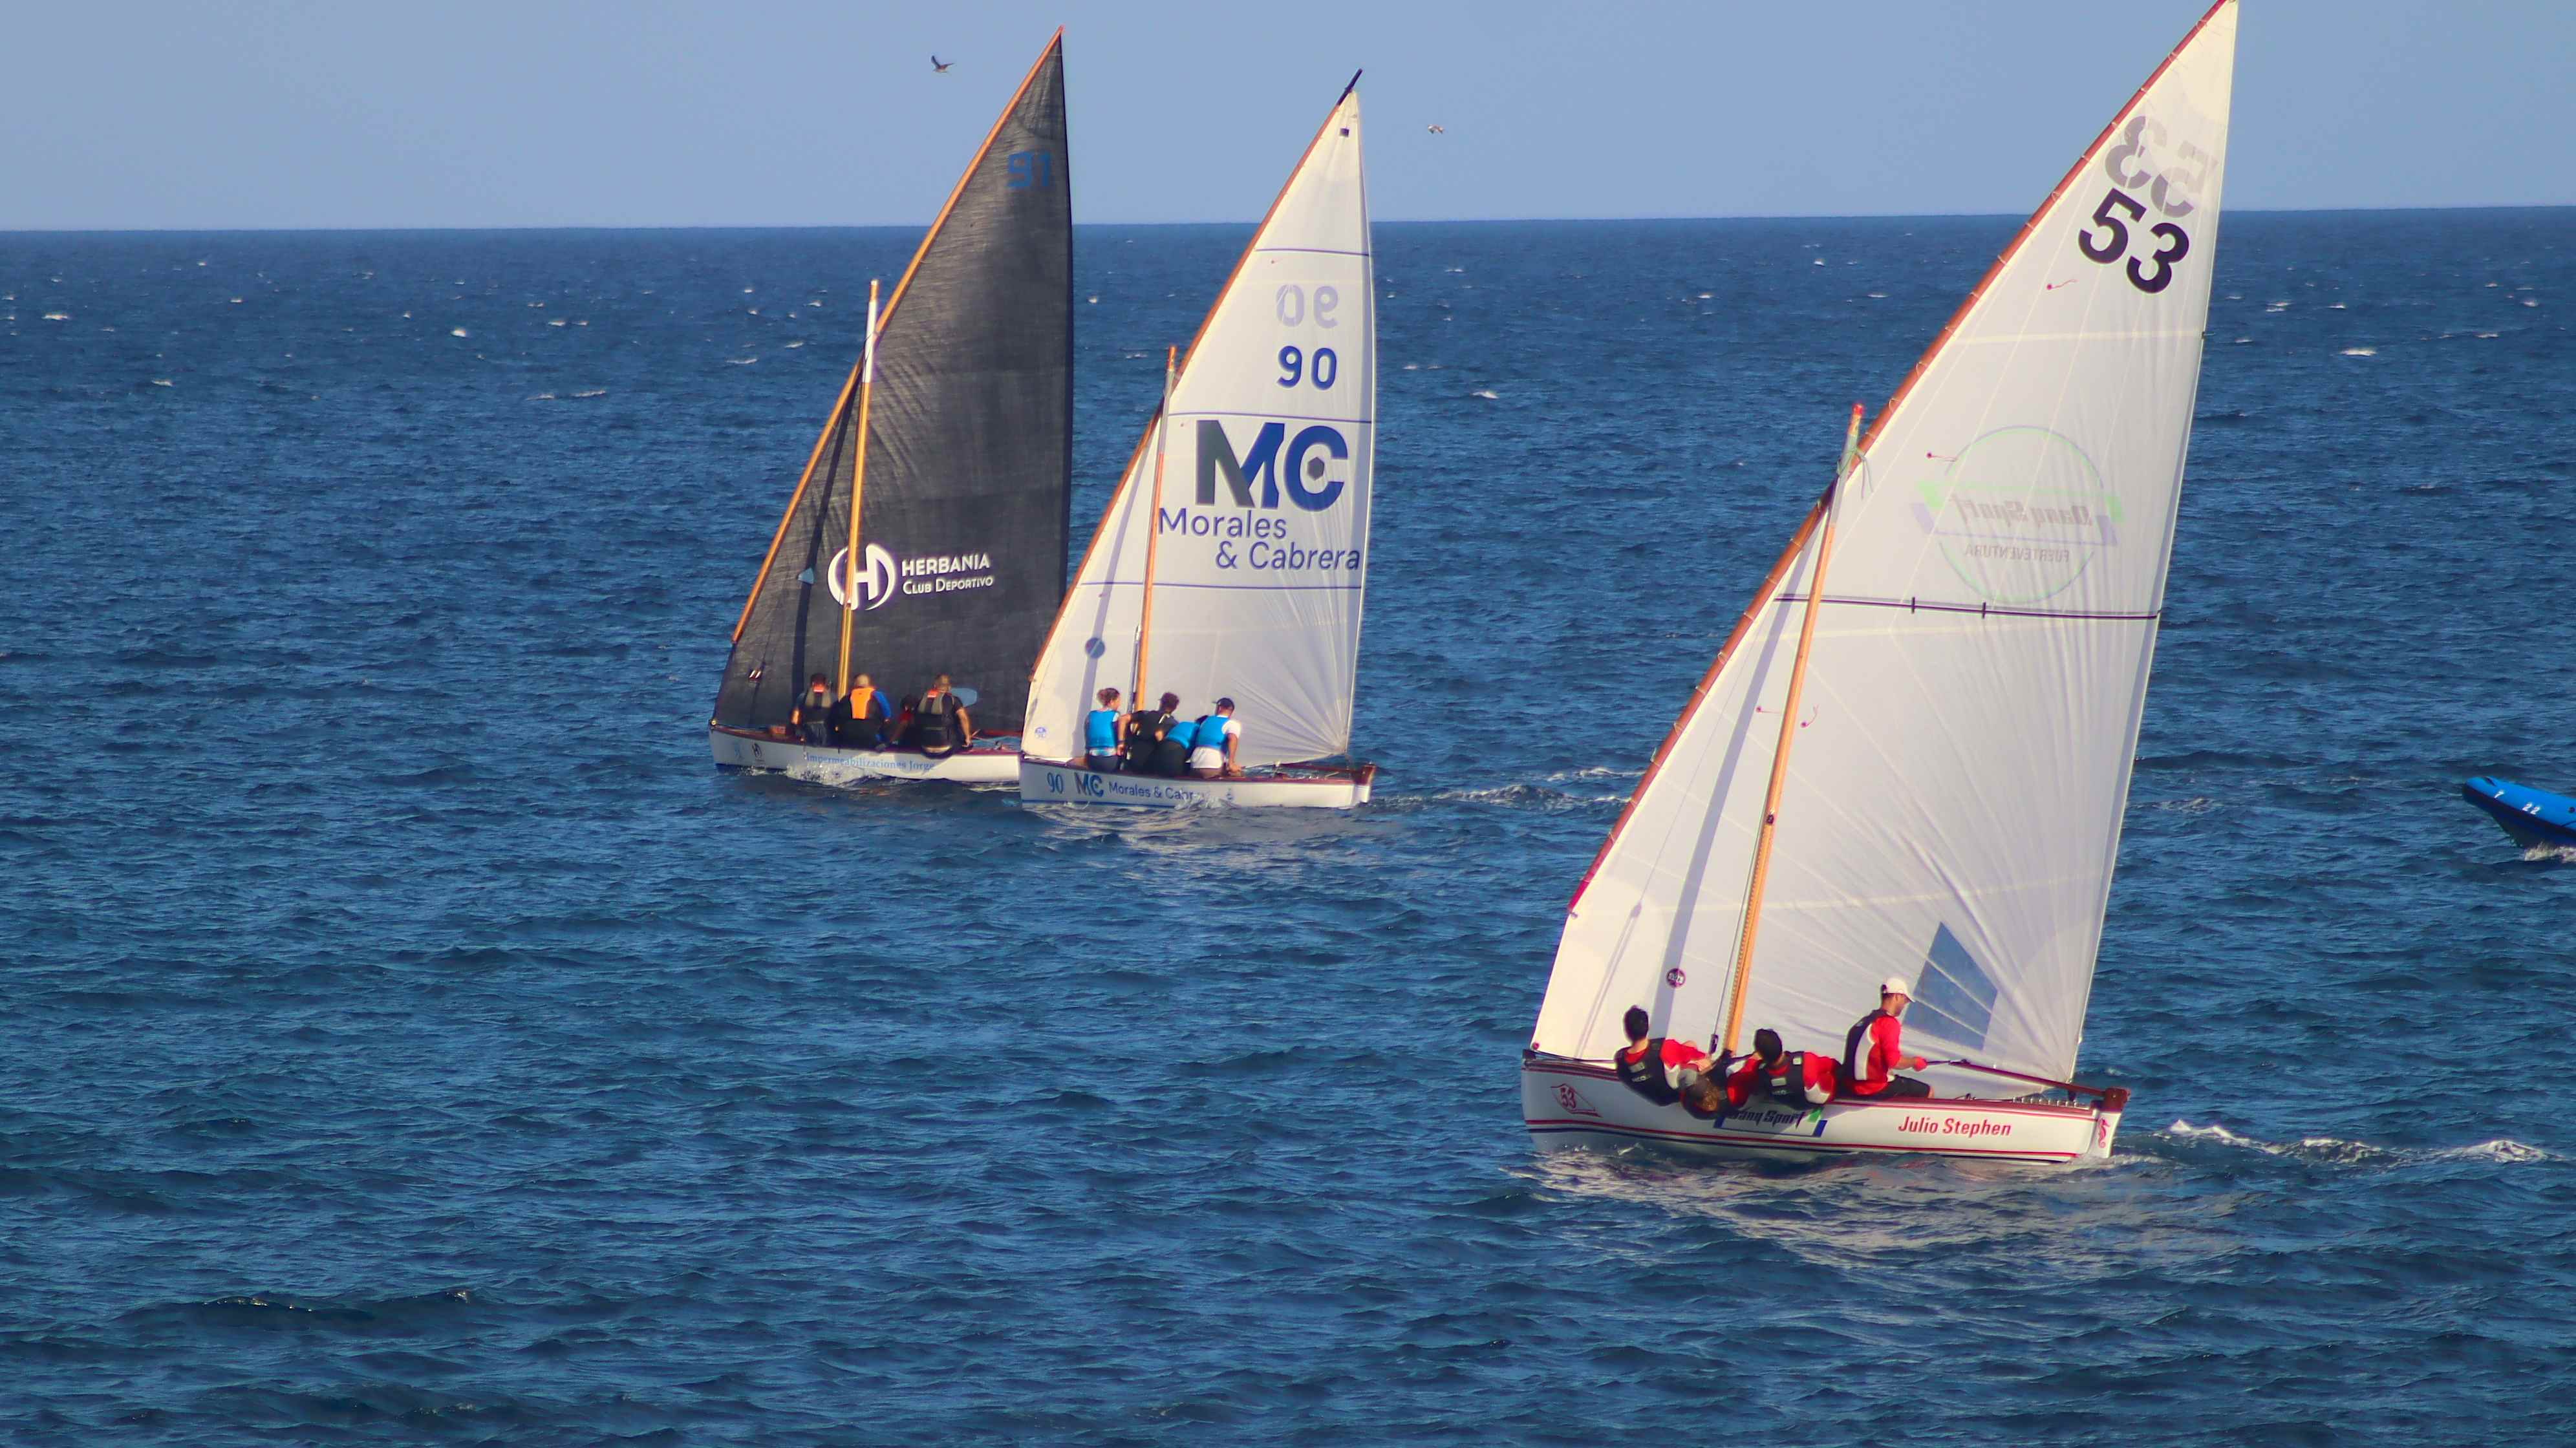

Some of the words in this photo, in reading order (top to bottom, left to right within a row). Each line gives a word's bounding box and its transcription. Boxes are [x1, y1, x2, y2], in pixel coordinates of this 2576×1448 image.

[1007, 151, 1052, 187] 91
[2077, 187, 2190, 294] 53
[1277, 345, 1338, 391] 90
[1195, 419, 1349, 513] MC
[1158, 507, 1287, 540] Morales
[901, 553, 991, 577] HERBANIA
[1214, 540, 1238, 570] &
[1249, 541, 1361, 571] Cabrera
[910, 760, 936, 771] Jorge
[1046, 772, 1064, 794] 90
[1074, 772, 1104, 798] MC
[1108, 782, 1151, 798] Morales
[1154, 786, 1163, 798] &
[2522, 802, 2541, 815] 22
[1560, 1086, 1576, 1109] 53
[1764, 1109, 1806, 1129] Sport
[1898, 1116, 1938, 1134] Julio
[1942, 1117, 2012, 1138] Stephen
